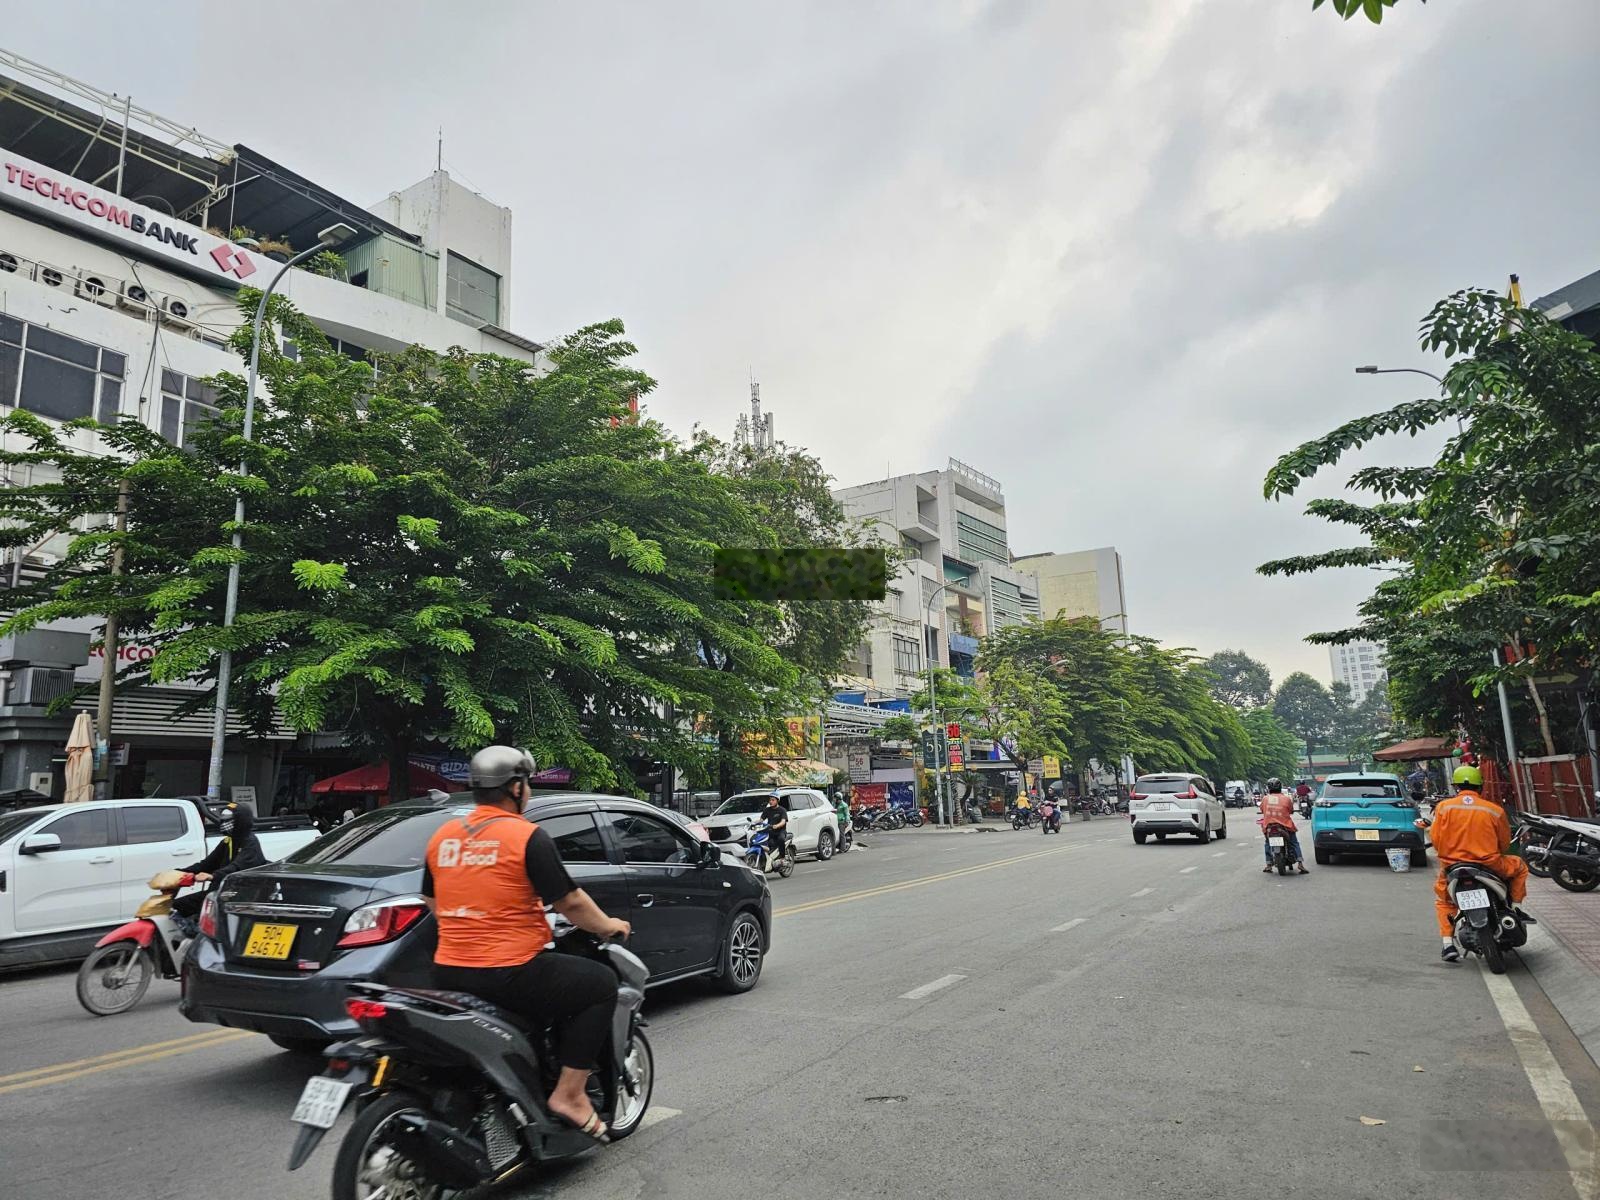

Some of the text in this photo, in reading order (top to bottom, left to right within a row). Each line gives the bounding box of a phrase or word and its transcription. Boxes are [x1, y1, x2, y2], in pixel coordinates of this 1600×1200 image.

[5, 162, 199, 255] TECHCOMBANK
[947, 723, 960, 738] 56
[461, 850, 498, 867] Food
